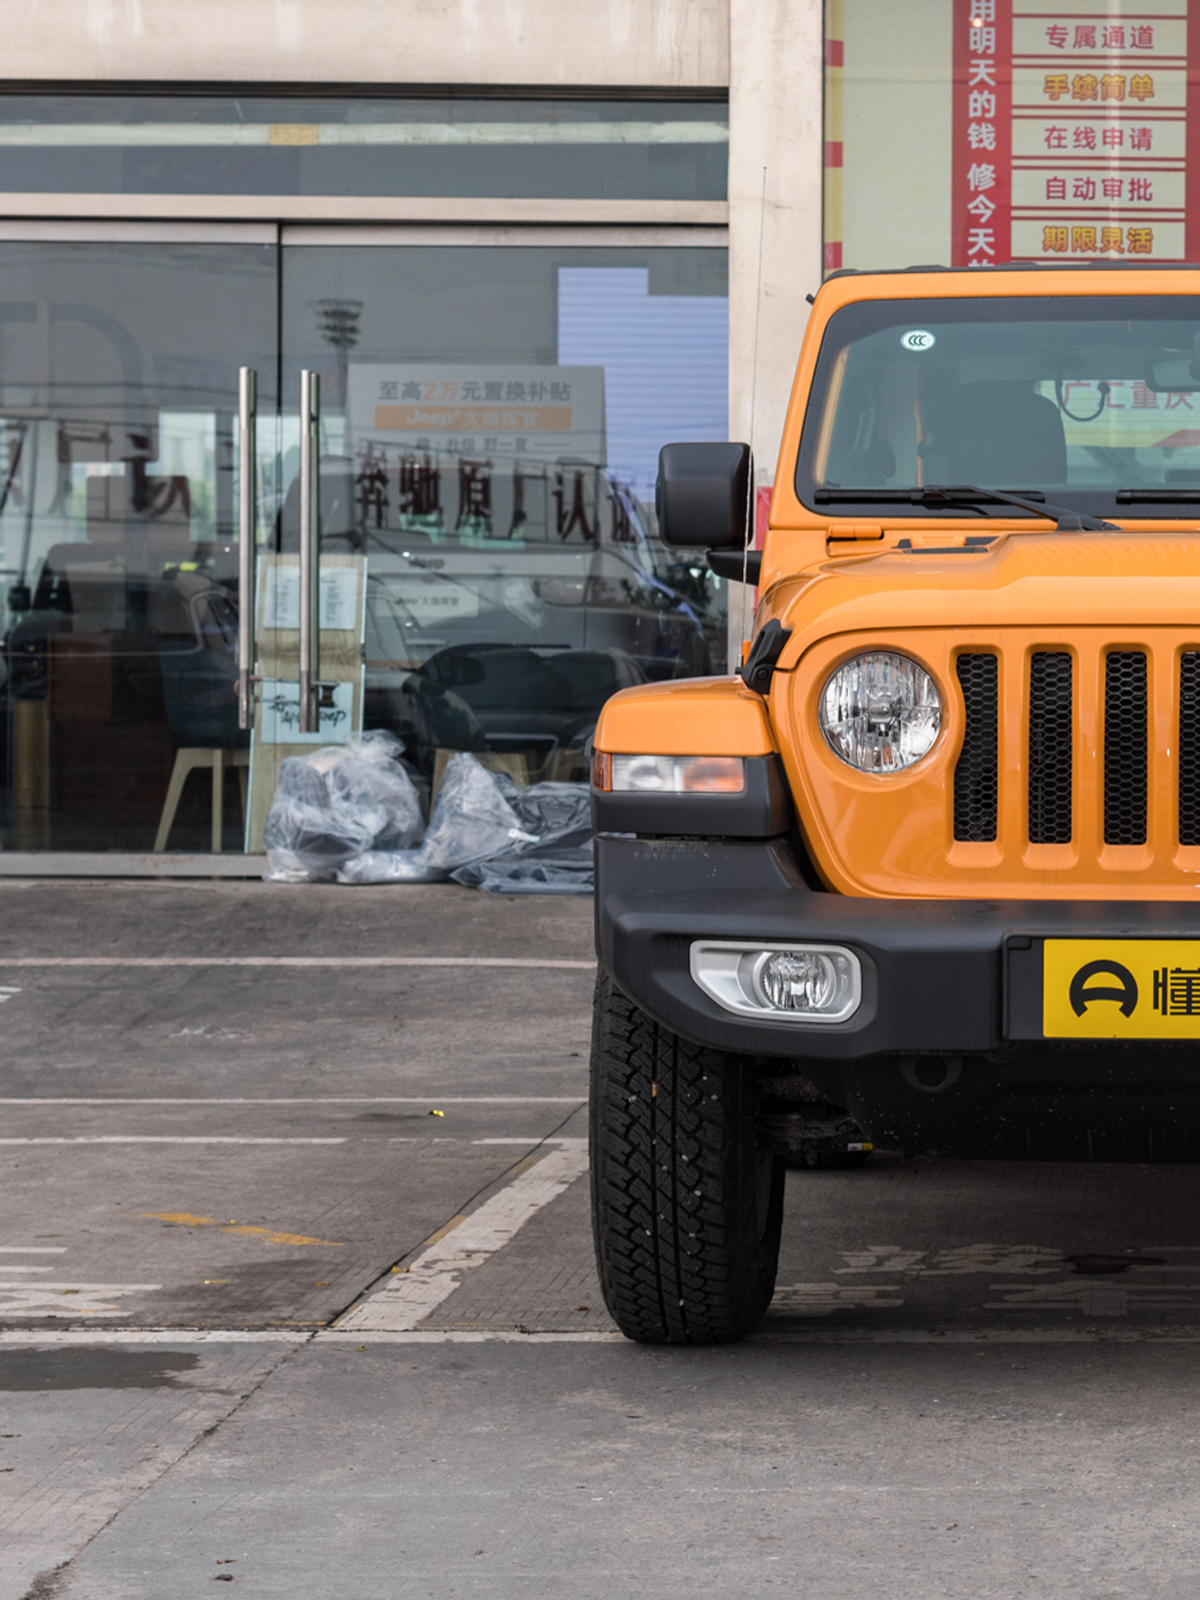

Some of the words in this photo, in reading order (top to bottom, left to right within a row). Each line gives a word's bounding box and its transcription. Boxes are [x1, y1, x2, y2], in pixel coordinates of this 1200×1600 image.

[1045, 25, 1155, 50] 专属通道
[1043, 74, 1155, 101] 手续简单
[1043, 127, 1153, 152] 在线申请
[1044, 177, 1153, 202] 自动审批
[1042, 226, 1155, 255] 期限灵活
